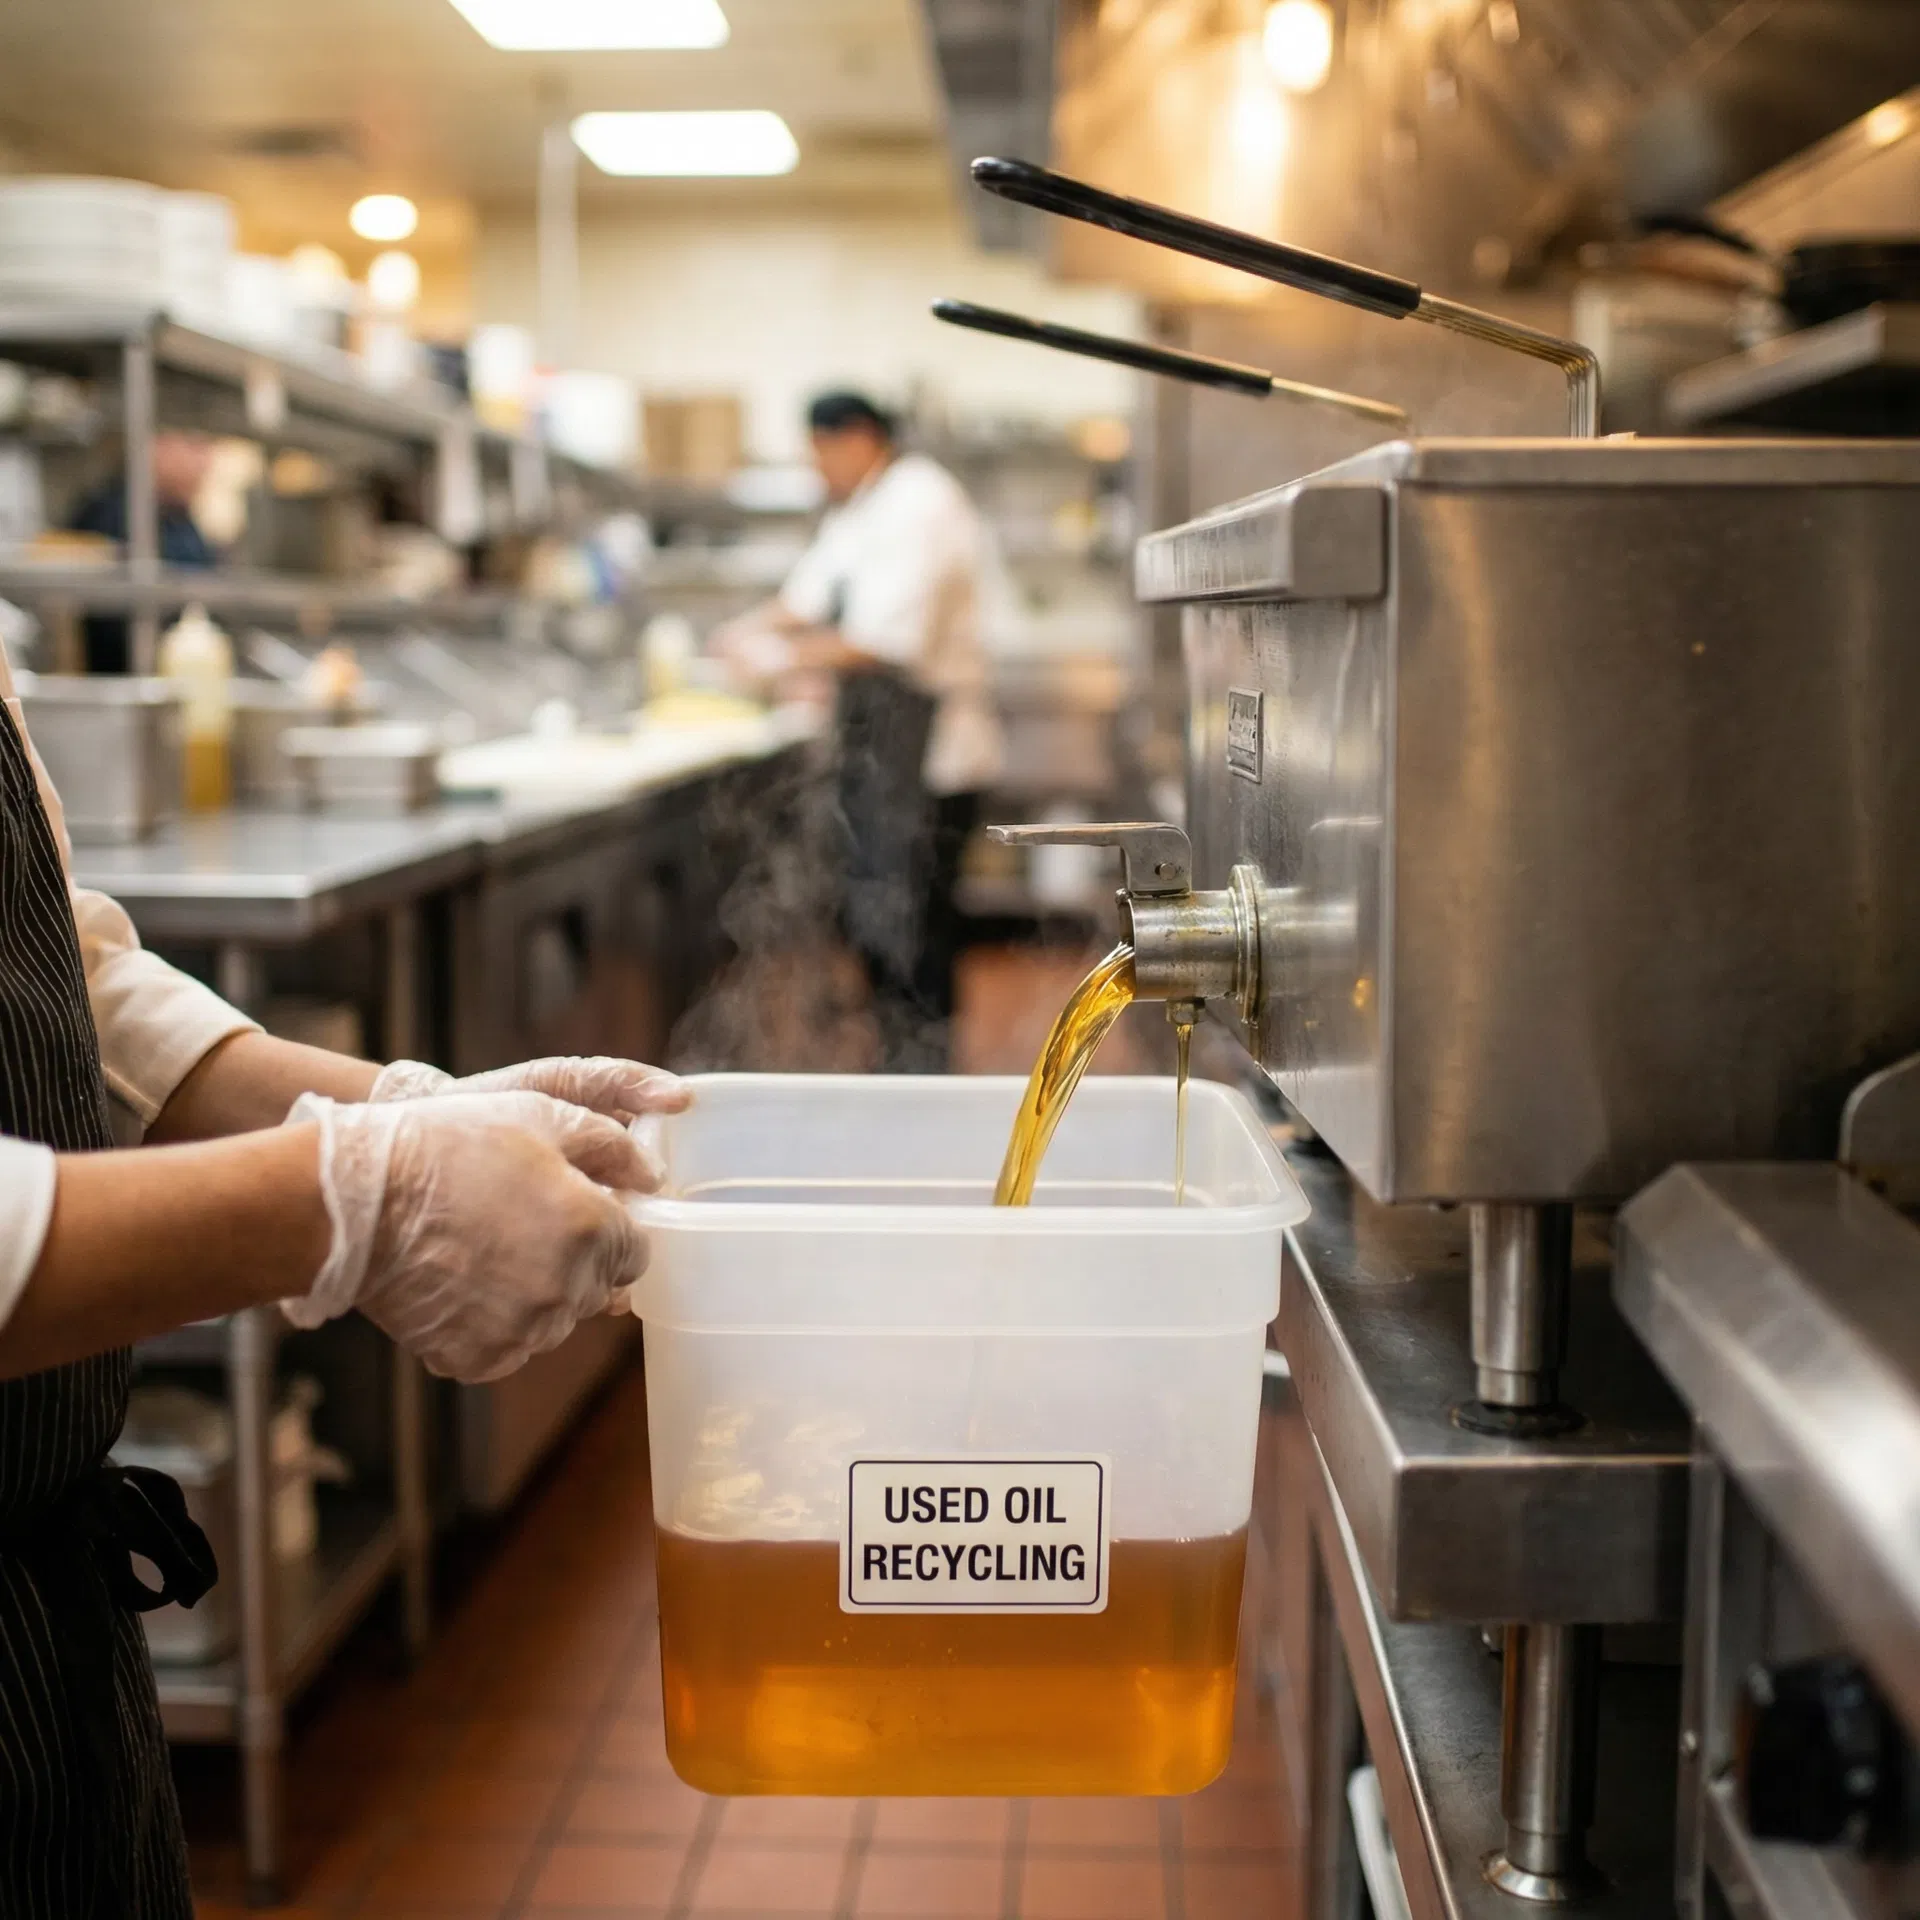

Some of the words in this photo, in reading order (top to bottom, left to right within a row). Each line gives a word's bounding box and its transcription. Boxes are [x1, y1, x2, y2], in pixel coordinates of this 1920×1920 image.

[884, 1486, 989, 1524] USED
[1004, 1486, 1067, 1524] OIL
[863, 1543, 1086, 1582] RECYCLING
